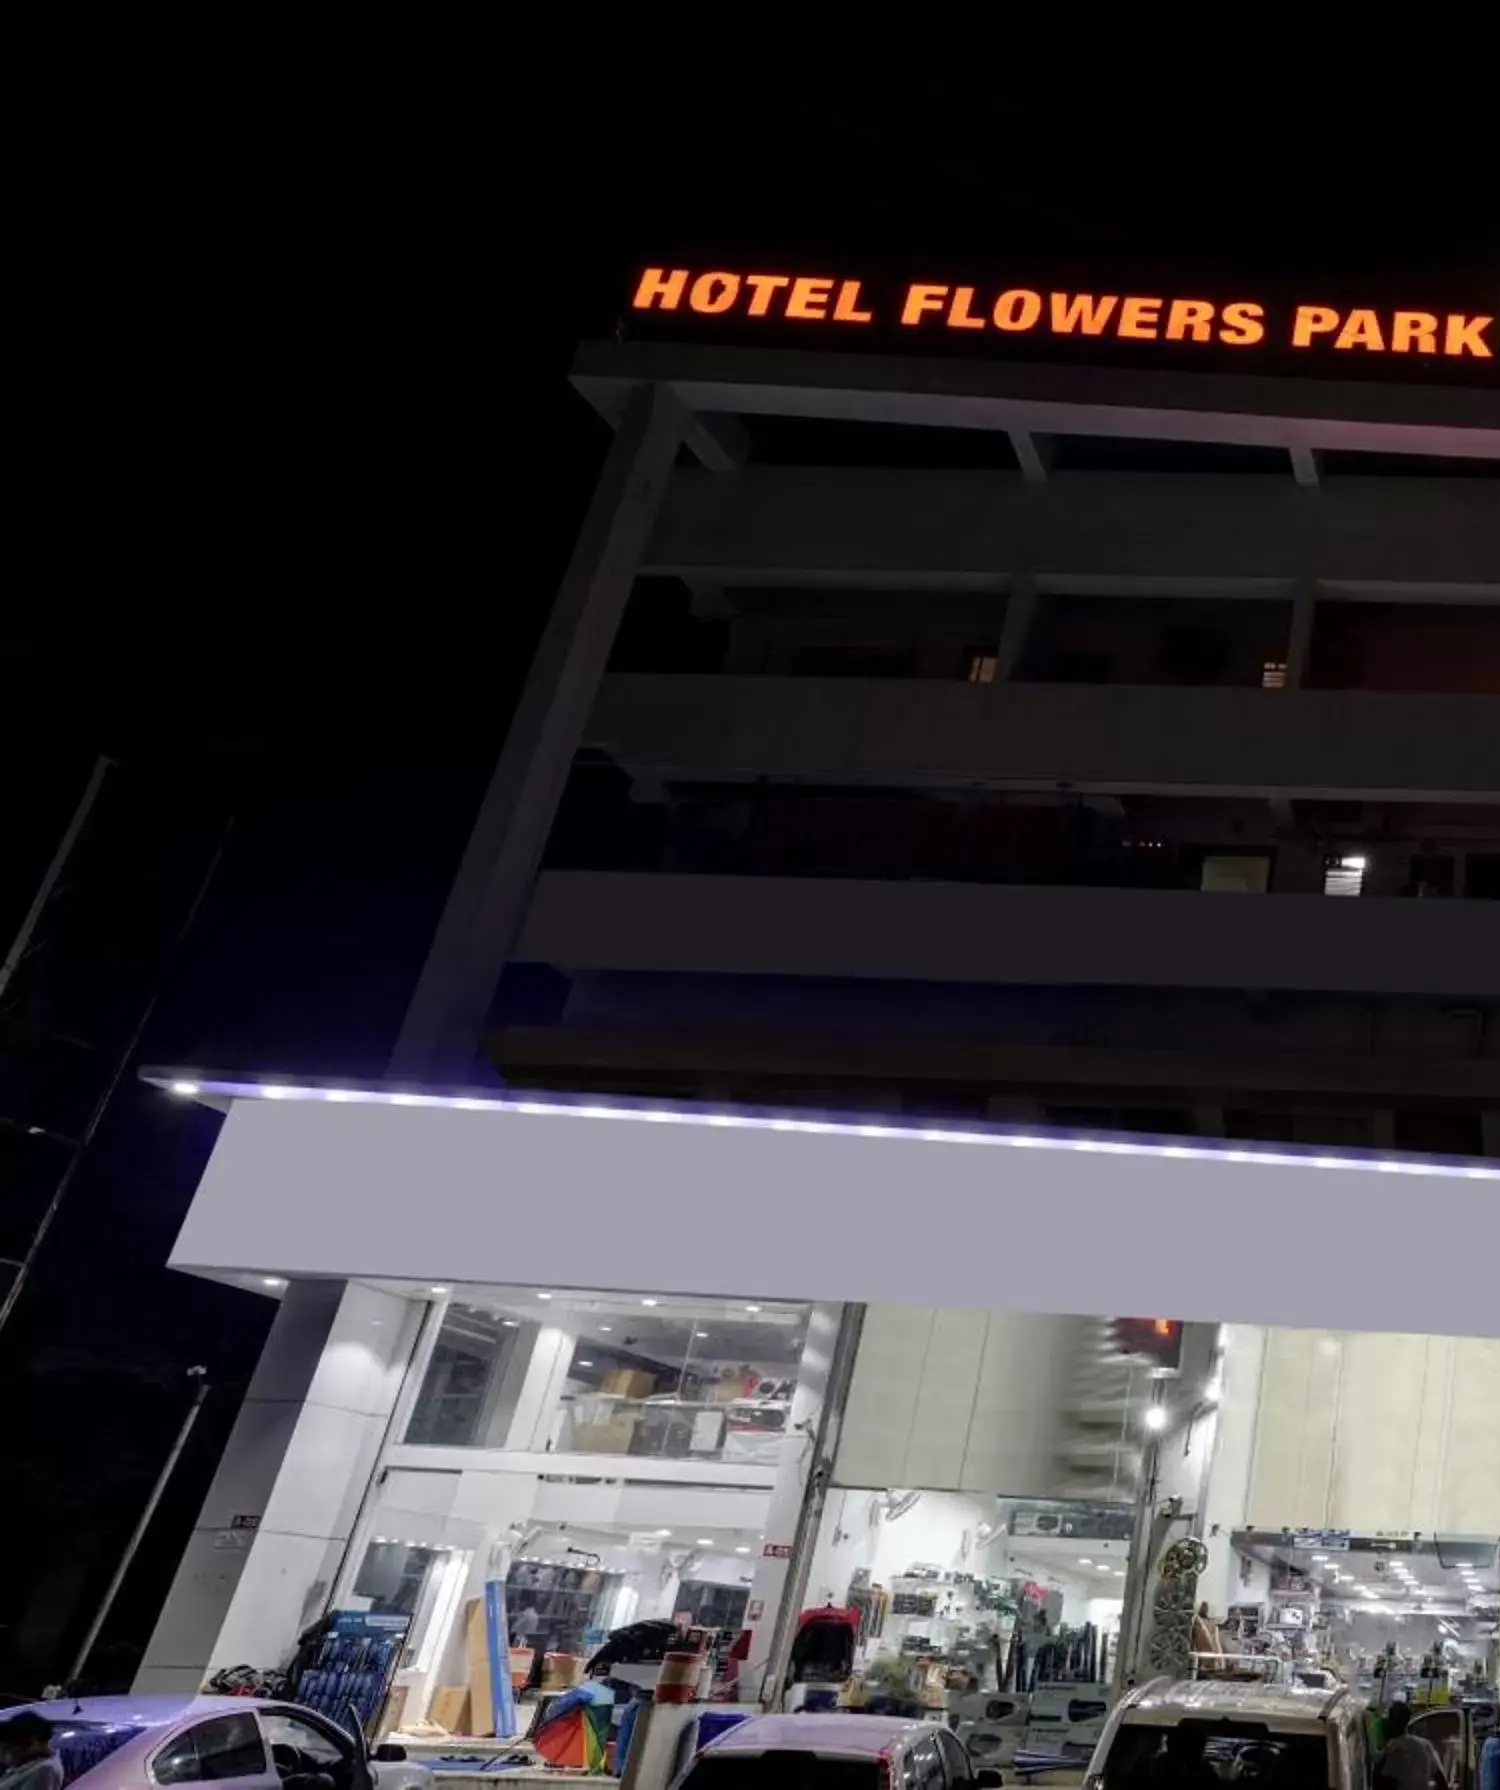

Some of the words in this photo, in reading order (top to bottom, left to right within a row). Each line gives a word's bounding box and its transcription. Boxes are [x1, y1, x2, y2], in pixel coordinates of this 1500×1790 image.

[632, 268, 872, 322] HOTEL
[900, 284, 1265, 345] FLOWERS
[1291, 304, 1494, 358] PARK
